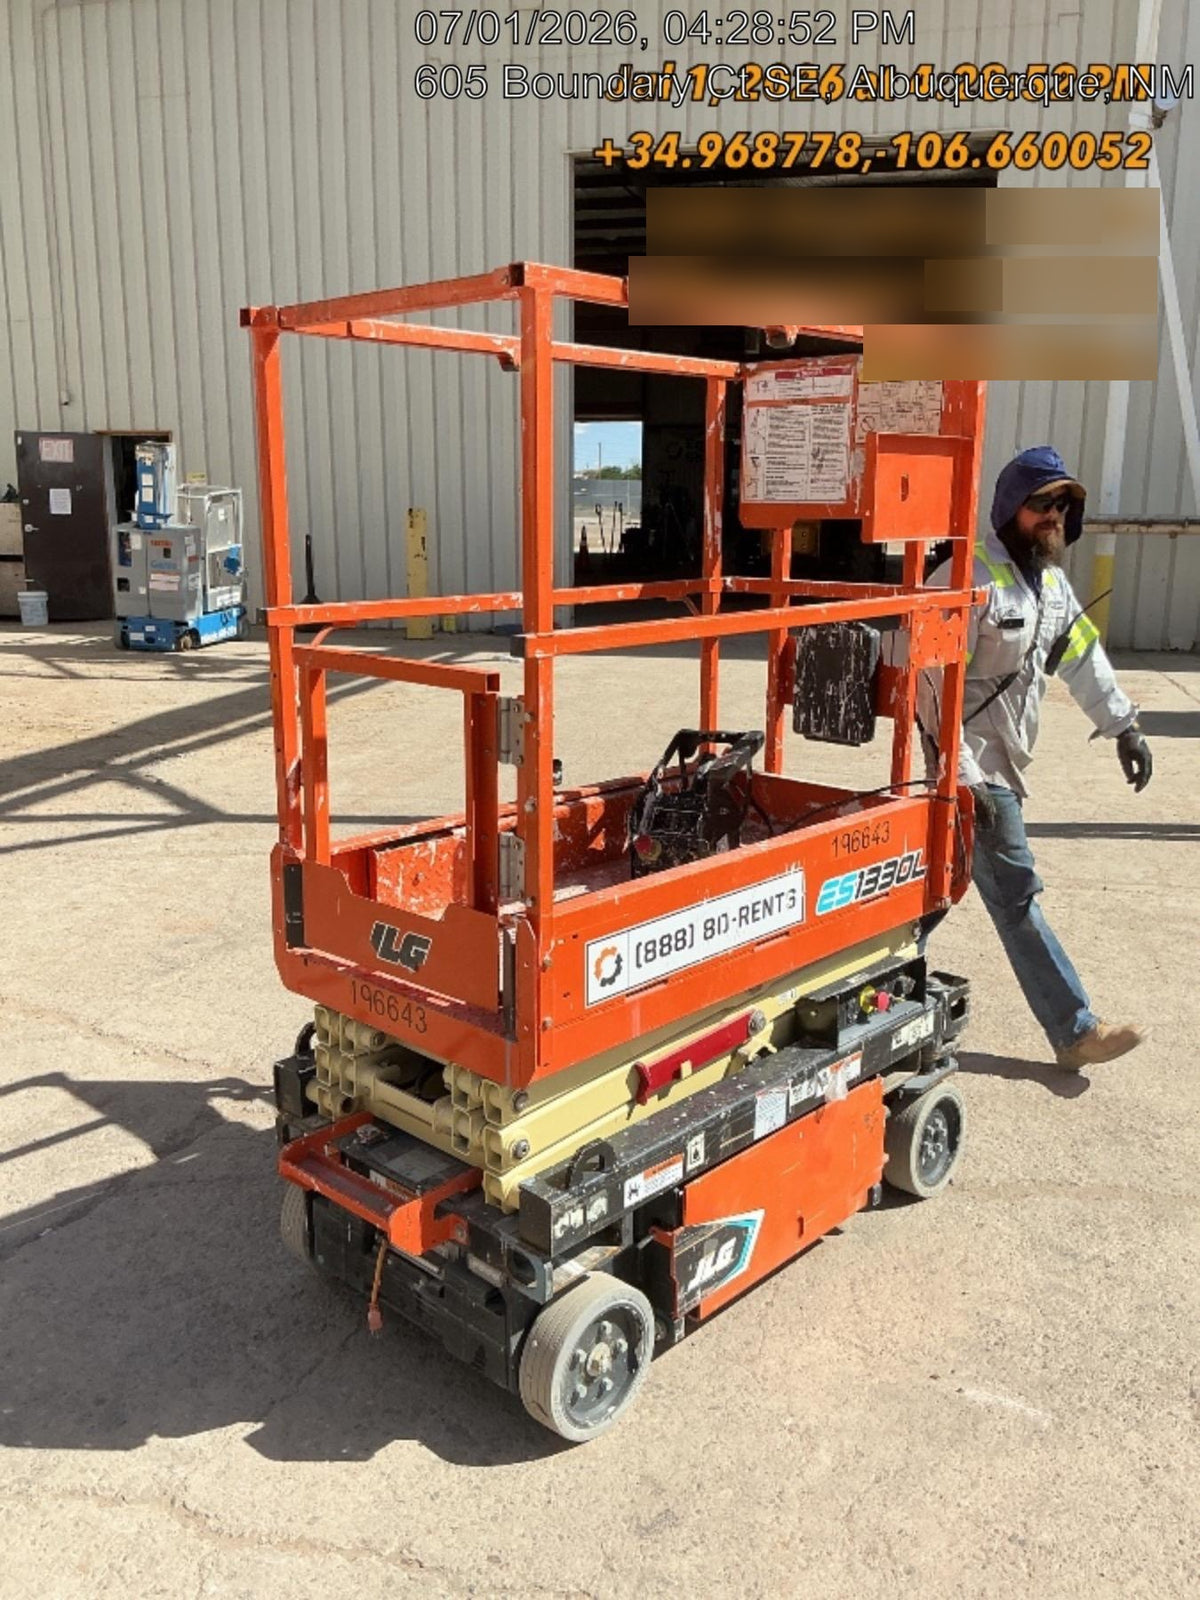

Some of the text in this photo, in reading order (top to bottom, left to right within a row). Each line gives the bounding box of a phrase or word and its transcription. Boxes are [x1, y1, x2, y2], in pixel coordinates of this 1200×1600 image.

[831, 821, 890, 858] 196643
[816, 849, 927, 914] ES1330L
[635, 924, 694, 969] (888)
[351, 979, 428, 1034] 196643
[687, 1236, 738, 1292] JLG
